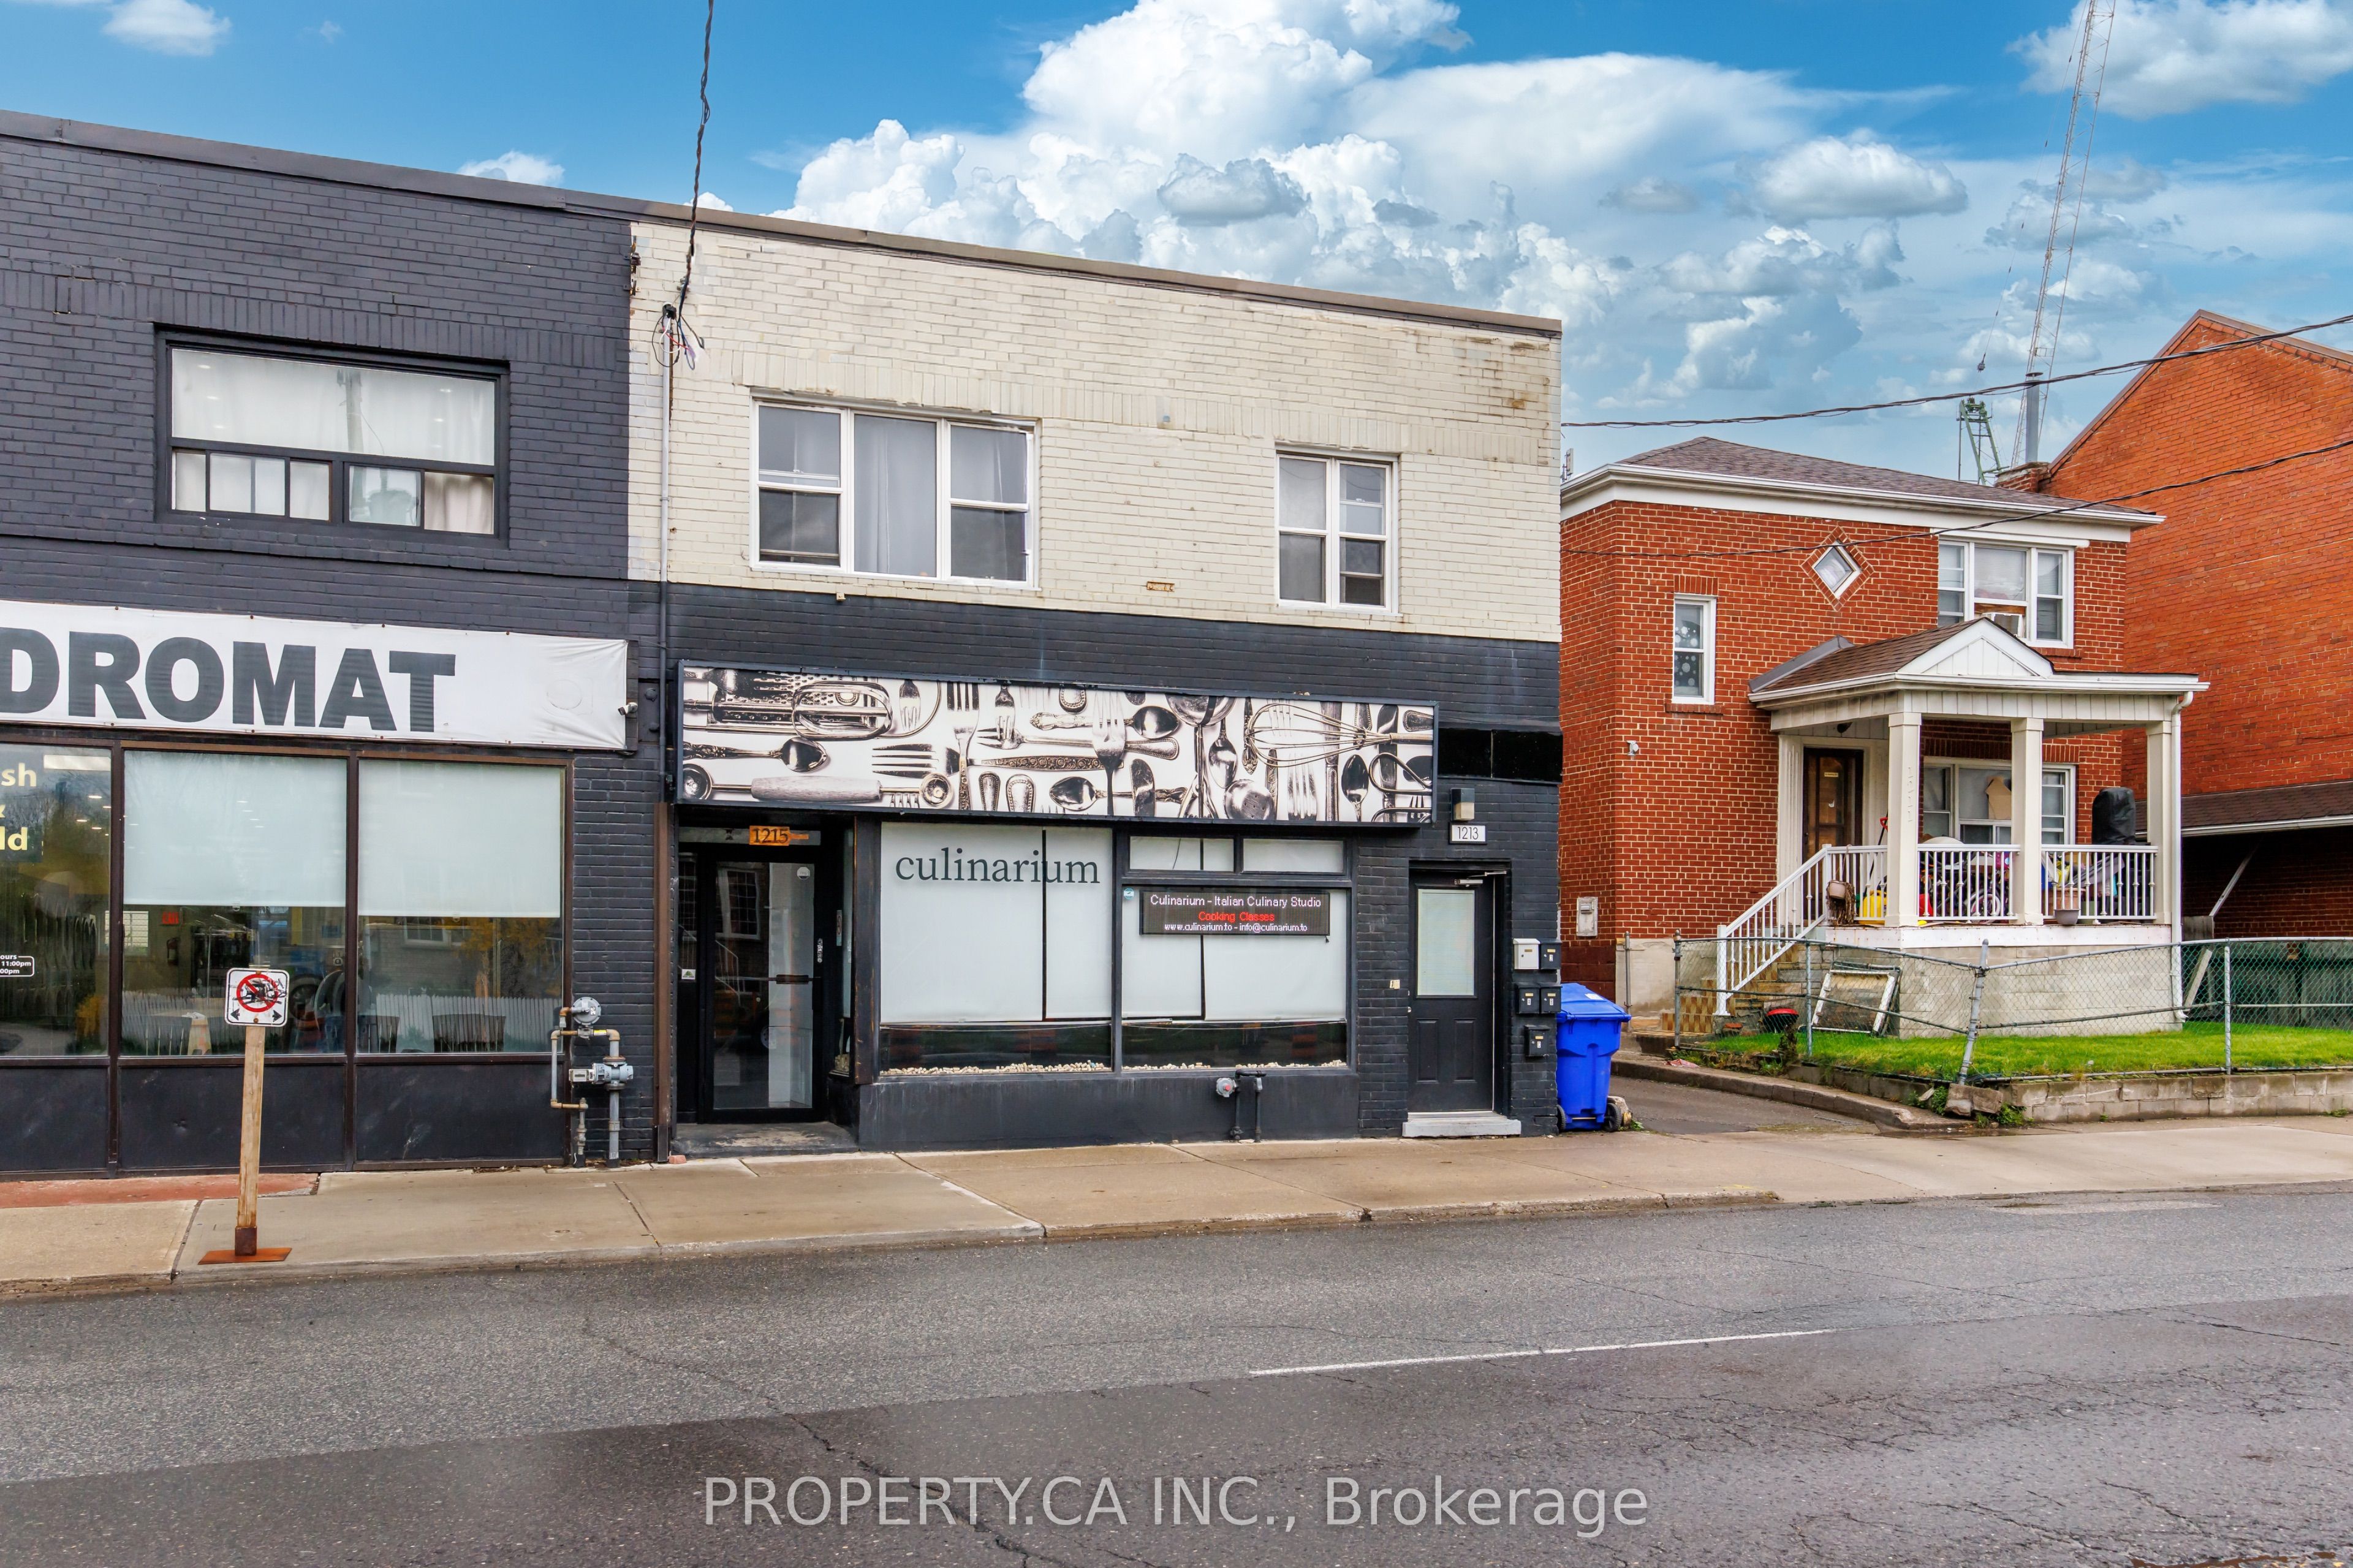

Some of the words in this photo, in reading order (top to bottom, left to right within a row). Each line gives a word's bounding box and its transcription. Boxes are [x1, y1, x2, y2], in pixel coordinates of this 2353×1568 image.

[753, 827, 789, 844] 1215
[1457, 826, 1479, 840] 1213
[896, 847, 1101, 884] culinarium
[1150, 895, 1205, 906] Culinarium
[1214, 895, 1244, 906] Italian
[1247, 896, 1287, 909] Culinary
[1290, 896, 1321, 907] Studio
[1199, 911, 1236, 923] Cooking
[1239, 912, 1275, 922] Classes
[1239, 923, 1308, 933] info@culinarium.to
